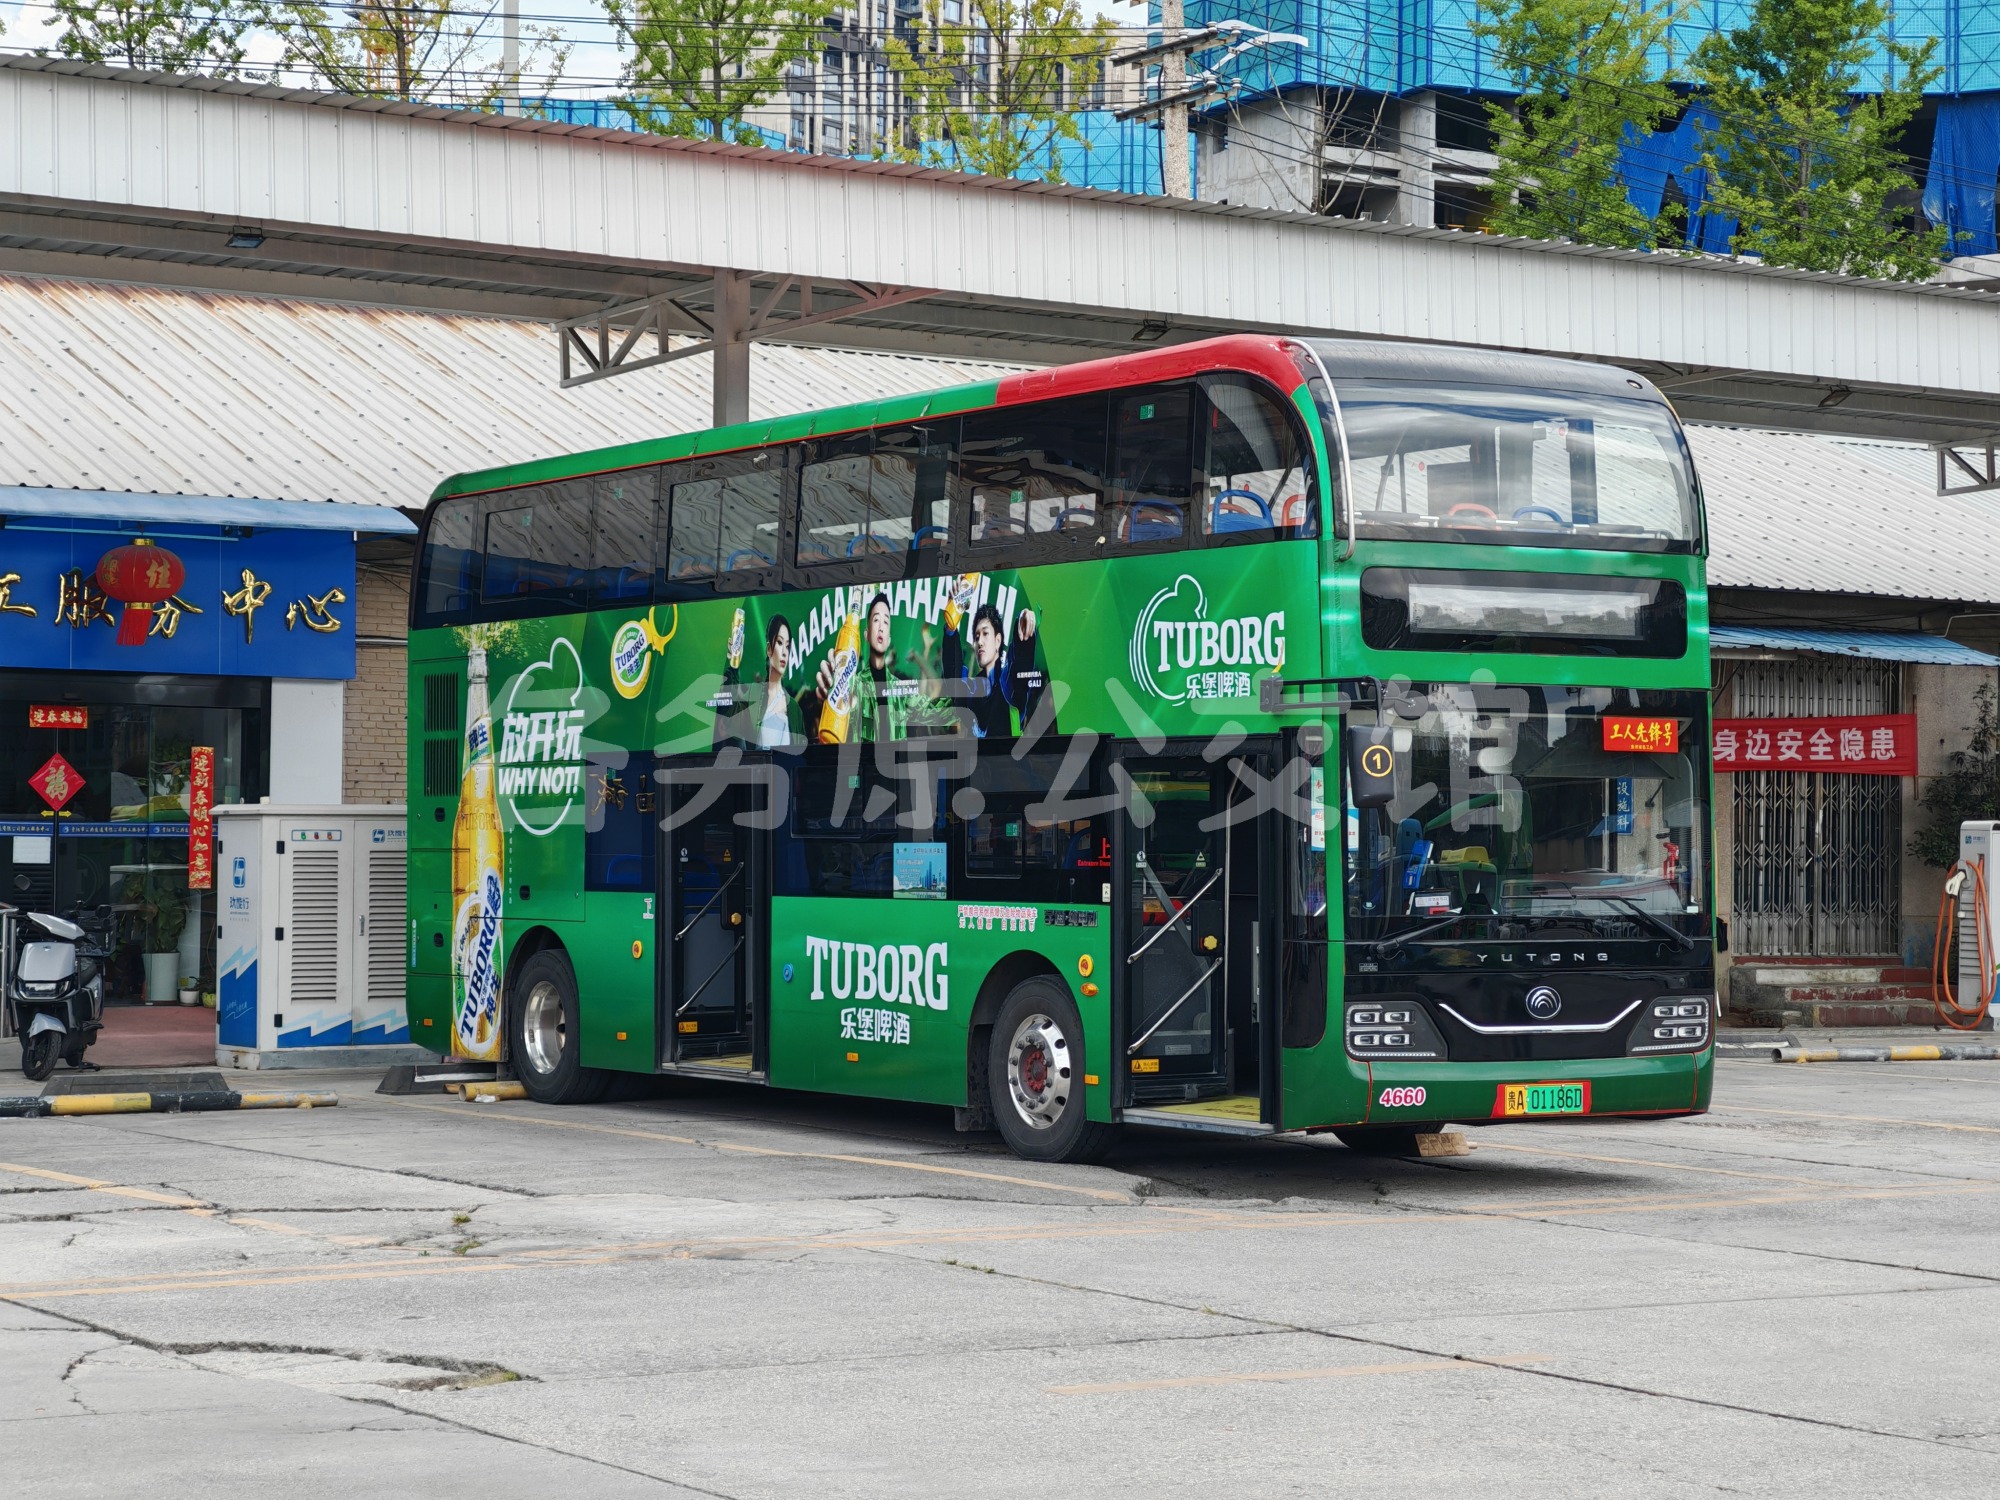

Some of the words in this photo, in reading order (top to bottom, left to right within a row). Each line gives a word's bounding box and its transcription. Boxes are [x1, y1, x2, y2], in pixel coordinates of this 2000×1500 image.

[615, 633, 645, 671] TUBORG
[1153, 611, 1286, 672] TUBORG
[829, 657, 856, 705] TUBORG
[1186, 671, 1251, 699] 乐堡啤酒
[499, 709, 585, 763] 放开玩
[1610, 721, 1673, 747] 工人先锋号
[1712, 726, 1897, 762] 身边安全隐患
[1372, 752, 1381, 770] 1
[44, 765, 69, 801] 福
[498, 767, 540, 795] WHY
[538, 766, 581, 794] NOT!
[1617, 781, 1631, 832] 设施科
[460, 906, 497, 1038] TUBORG
[806, 935, 949, 1011] TUBORG
[1477, 953, 1608, 962] YUTONG
[840, 1007, 911, 1045] 乐堡啤酒
[1379, 1087, 1427, 1108] 4660
